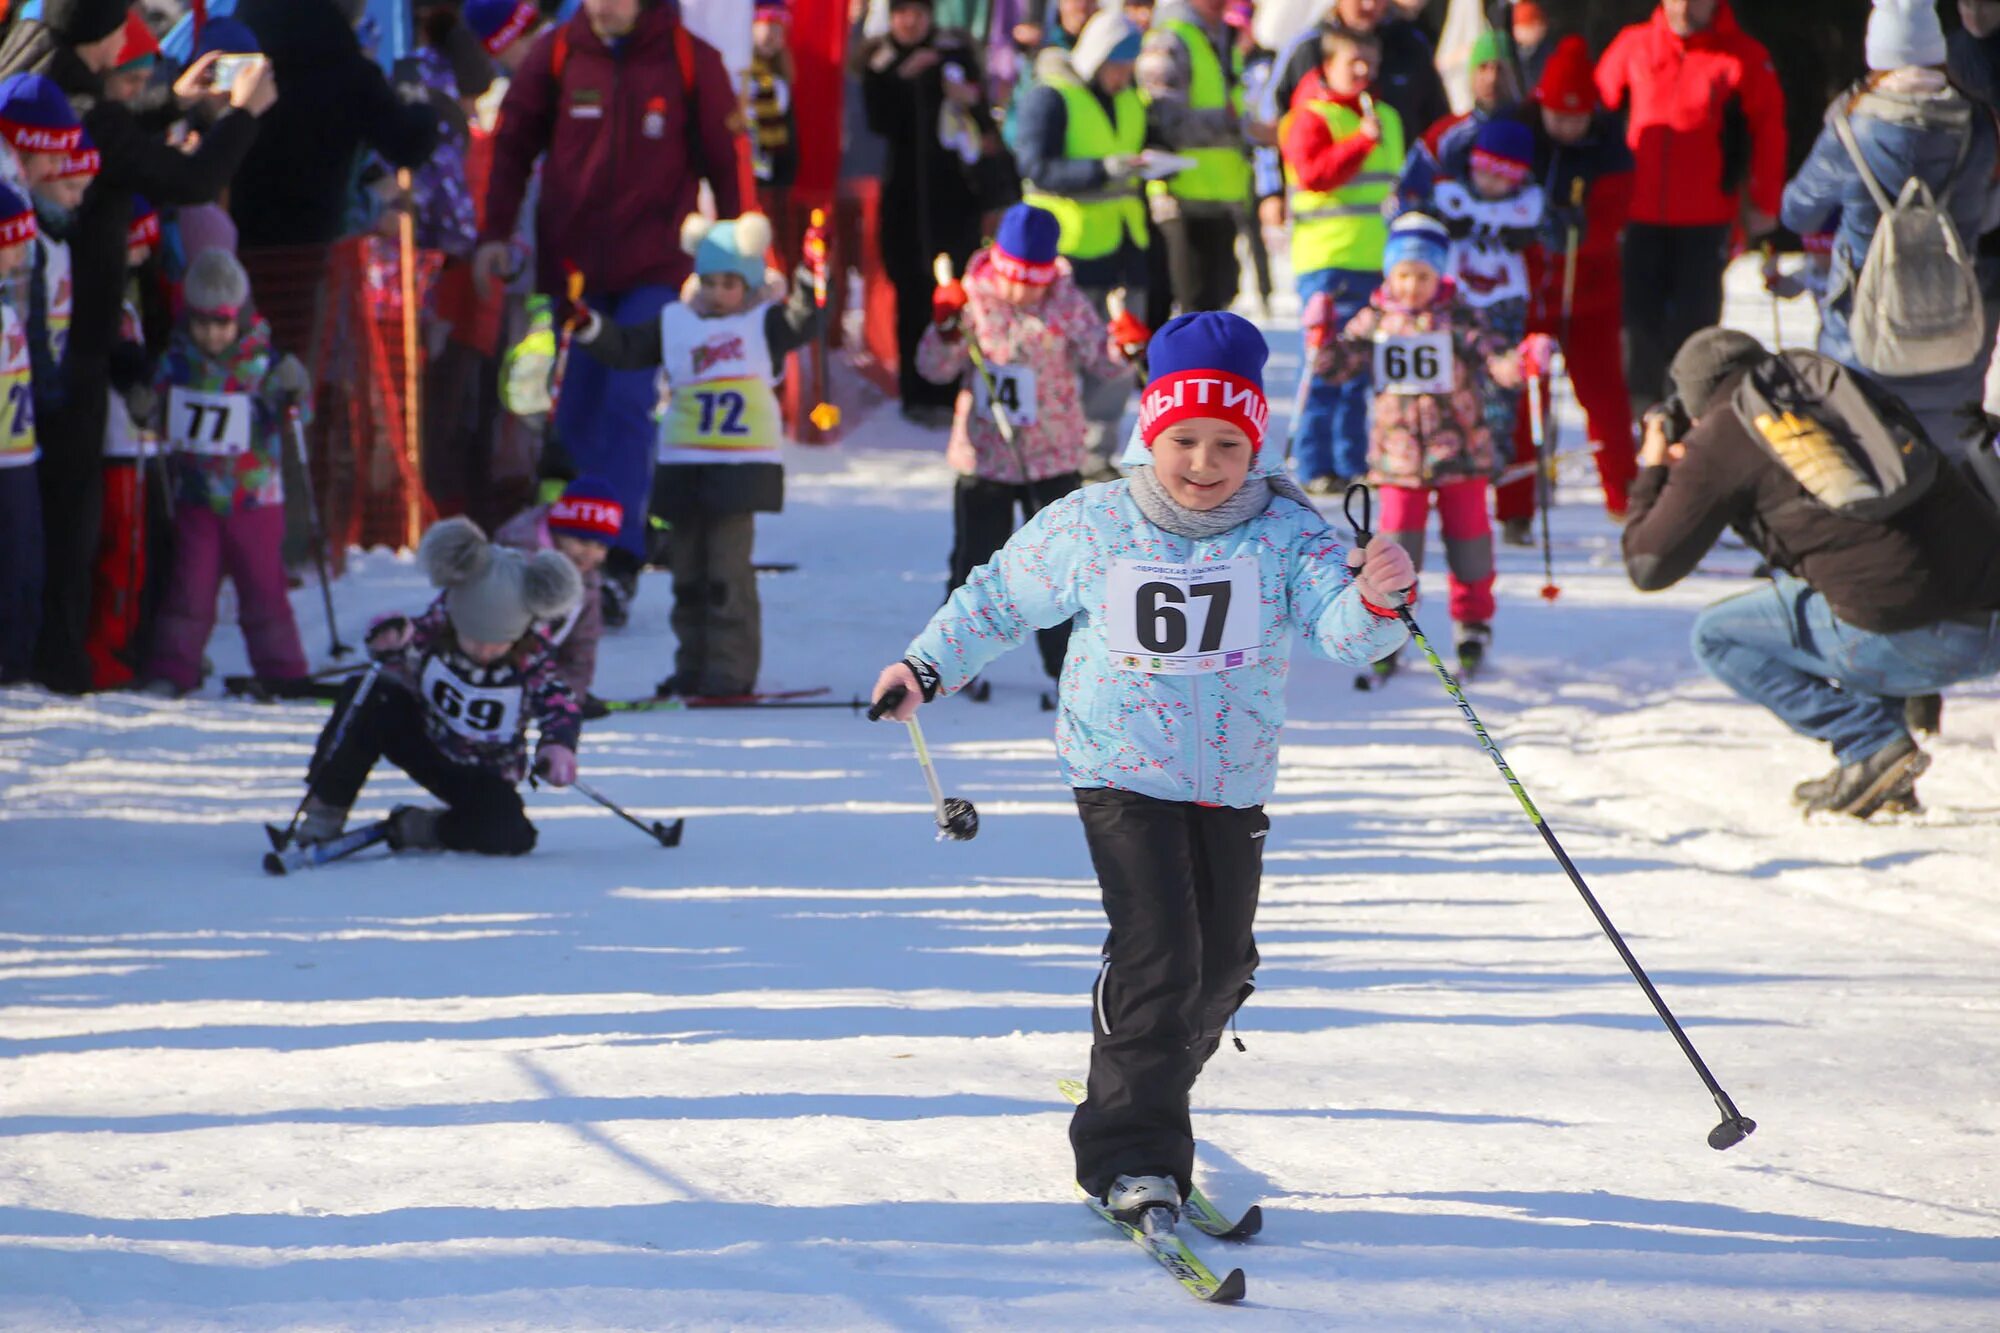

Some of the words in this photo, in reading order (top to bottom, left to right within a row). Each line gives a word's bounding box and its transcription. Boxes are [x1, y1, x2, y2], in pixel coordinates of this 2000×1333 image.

[1386, 345, 1438, 381] 66
[184, 402, 231, 442] 77
[1136, 580, 1231, 654] 67
[433, 680, 504, 731] 69
